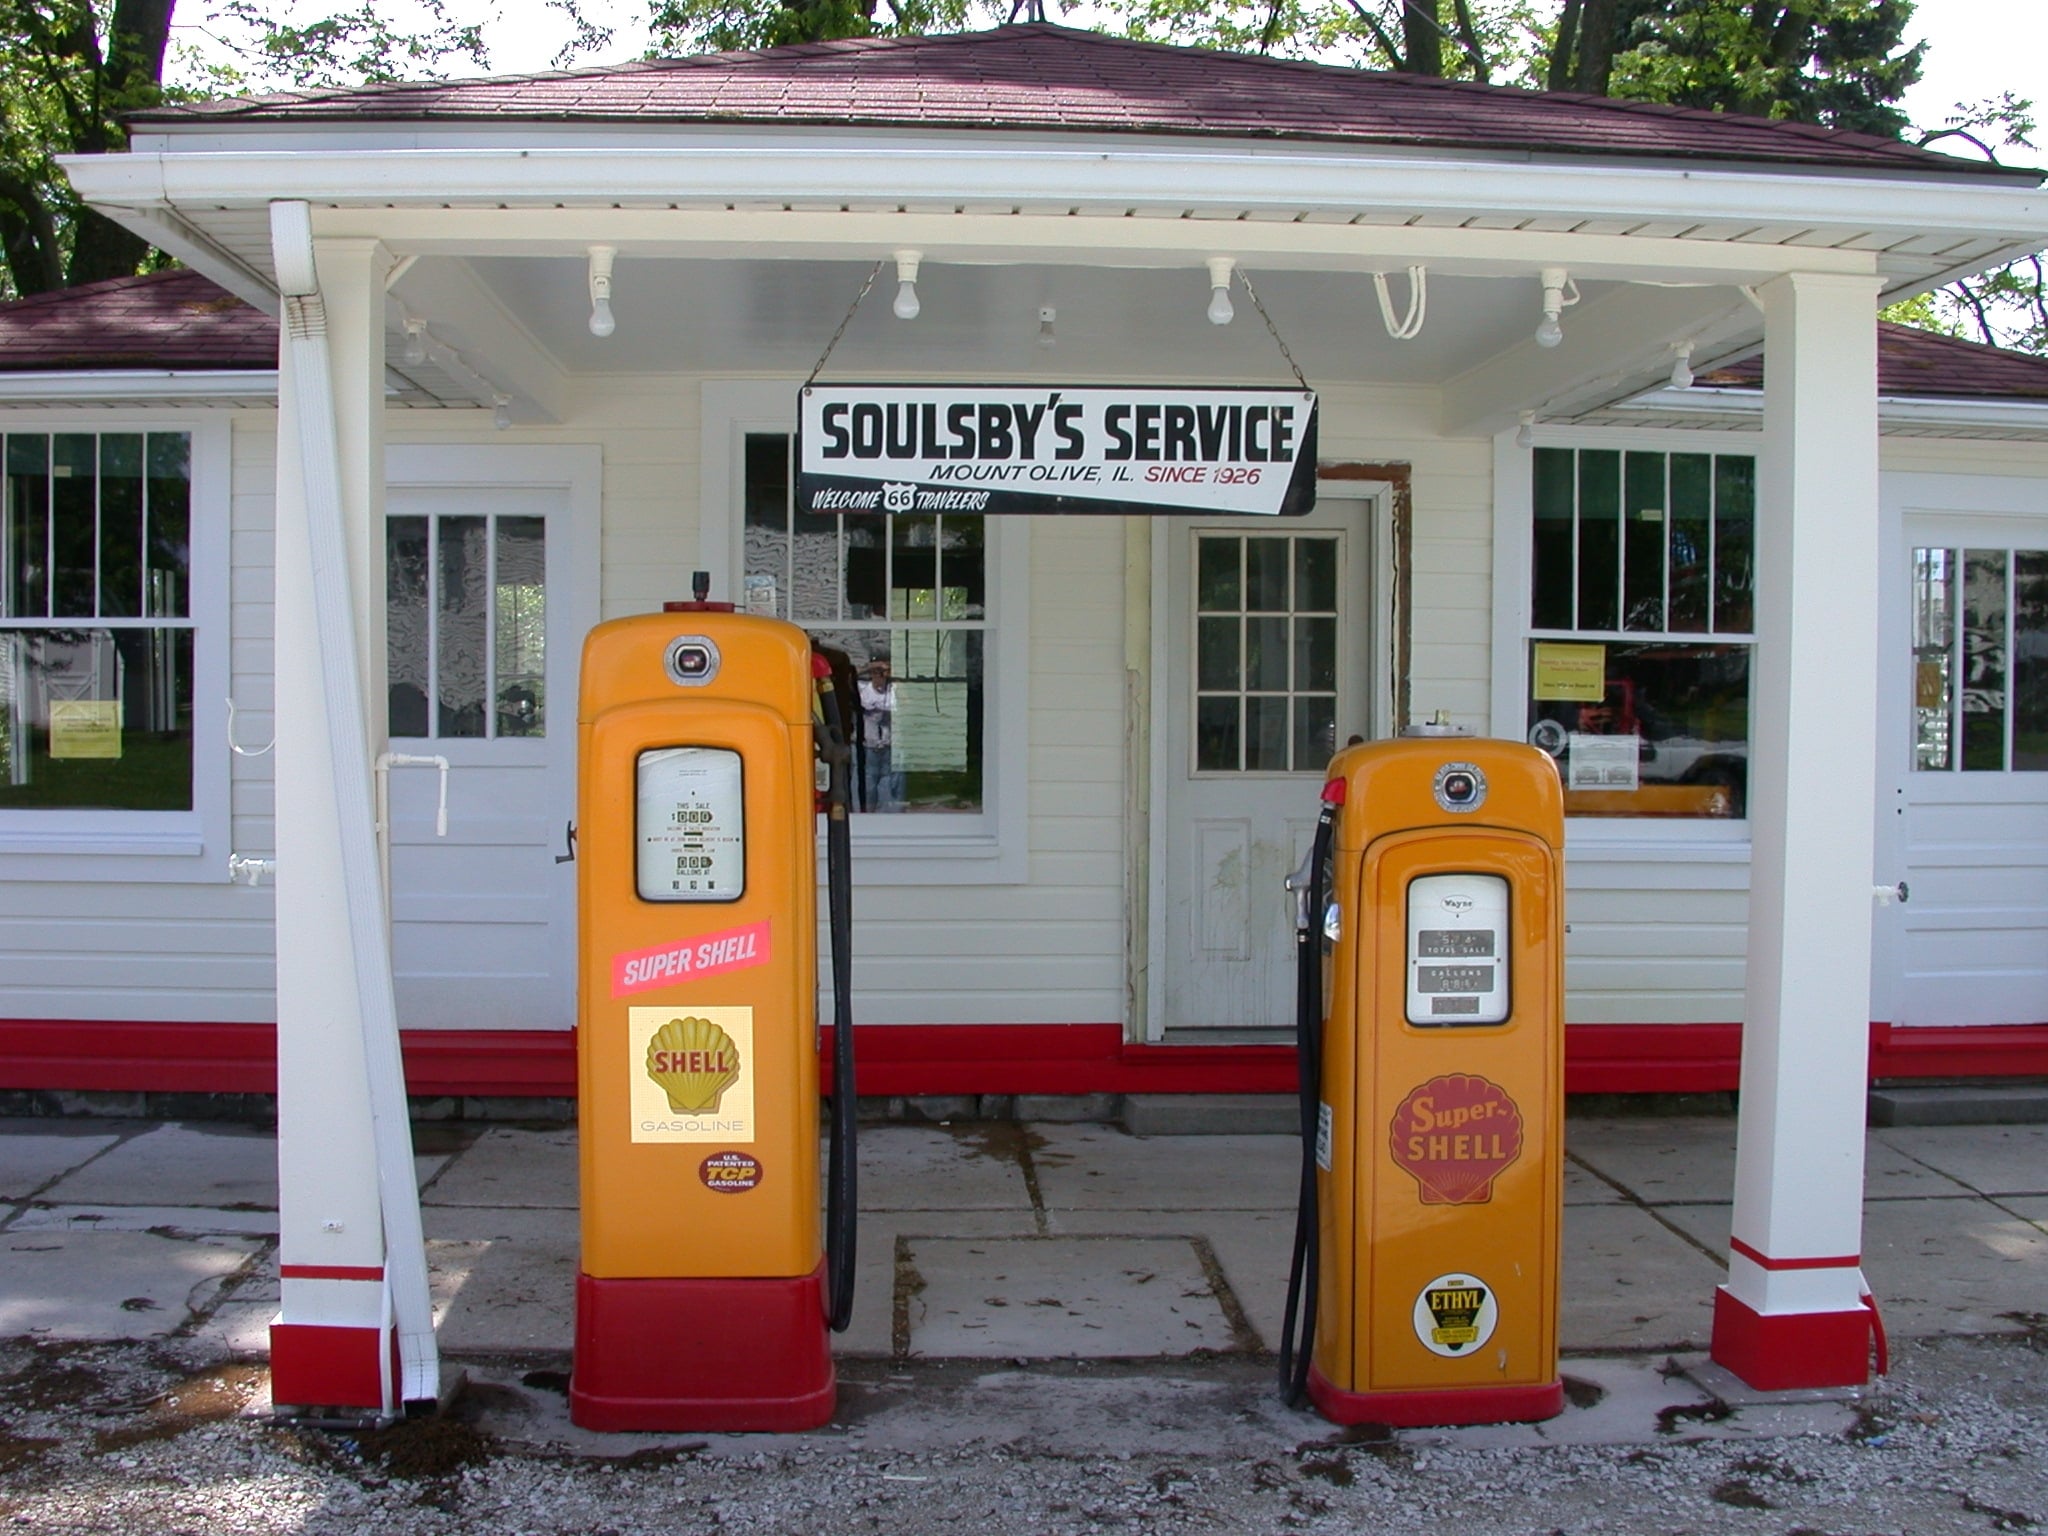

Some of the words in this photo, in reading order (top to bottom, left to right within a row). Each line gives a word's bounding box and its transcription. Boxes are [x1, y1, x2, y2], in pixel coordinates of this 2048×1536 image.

[822, 393, 1085, 461] SOULSBY'S
[1104, 404, 1295, 463] SERVICE
[928, 465, 1027, 481] MOUNT
[1029, 465, 1102, 486] OLIVE,
[1111, 467, 1135, 482] IL.
[1144, 466, 1207, 484] SINCE
[1213, 467, 1262, 485] 1926
[811, 487, 882, 510] WELCOME
[889, 490, 910, 506] 66
[916, 490, 991, 511] TRAVELERS
[676, 868, 702, 876] GALLONS
[1444, 899, 1472, 909] Wayne
[623, 948, 692, 986] SUPER
[696, 933, 757, 970] SHELL
[1431, 969, 1481, 977] GALLONS
[654, 1051, 730, 1074] SHELL
[1410, 1096, 1502, 1134] Super
[641, 1120, 744, 1132] GASOLINE
[1407, 1134, 1507, 1161] SHELL
[707, 1167, 756, 1180] TCP
[1431, 1290, 1481, 1310] ETHYL
